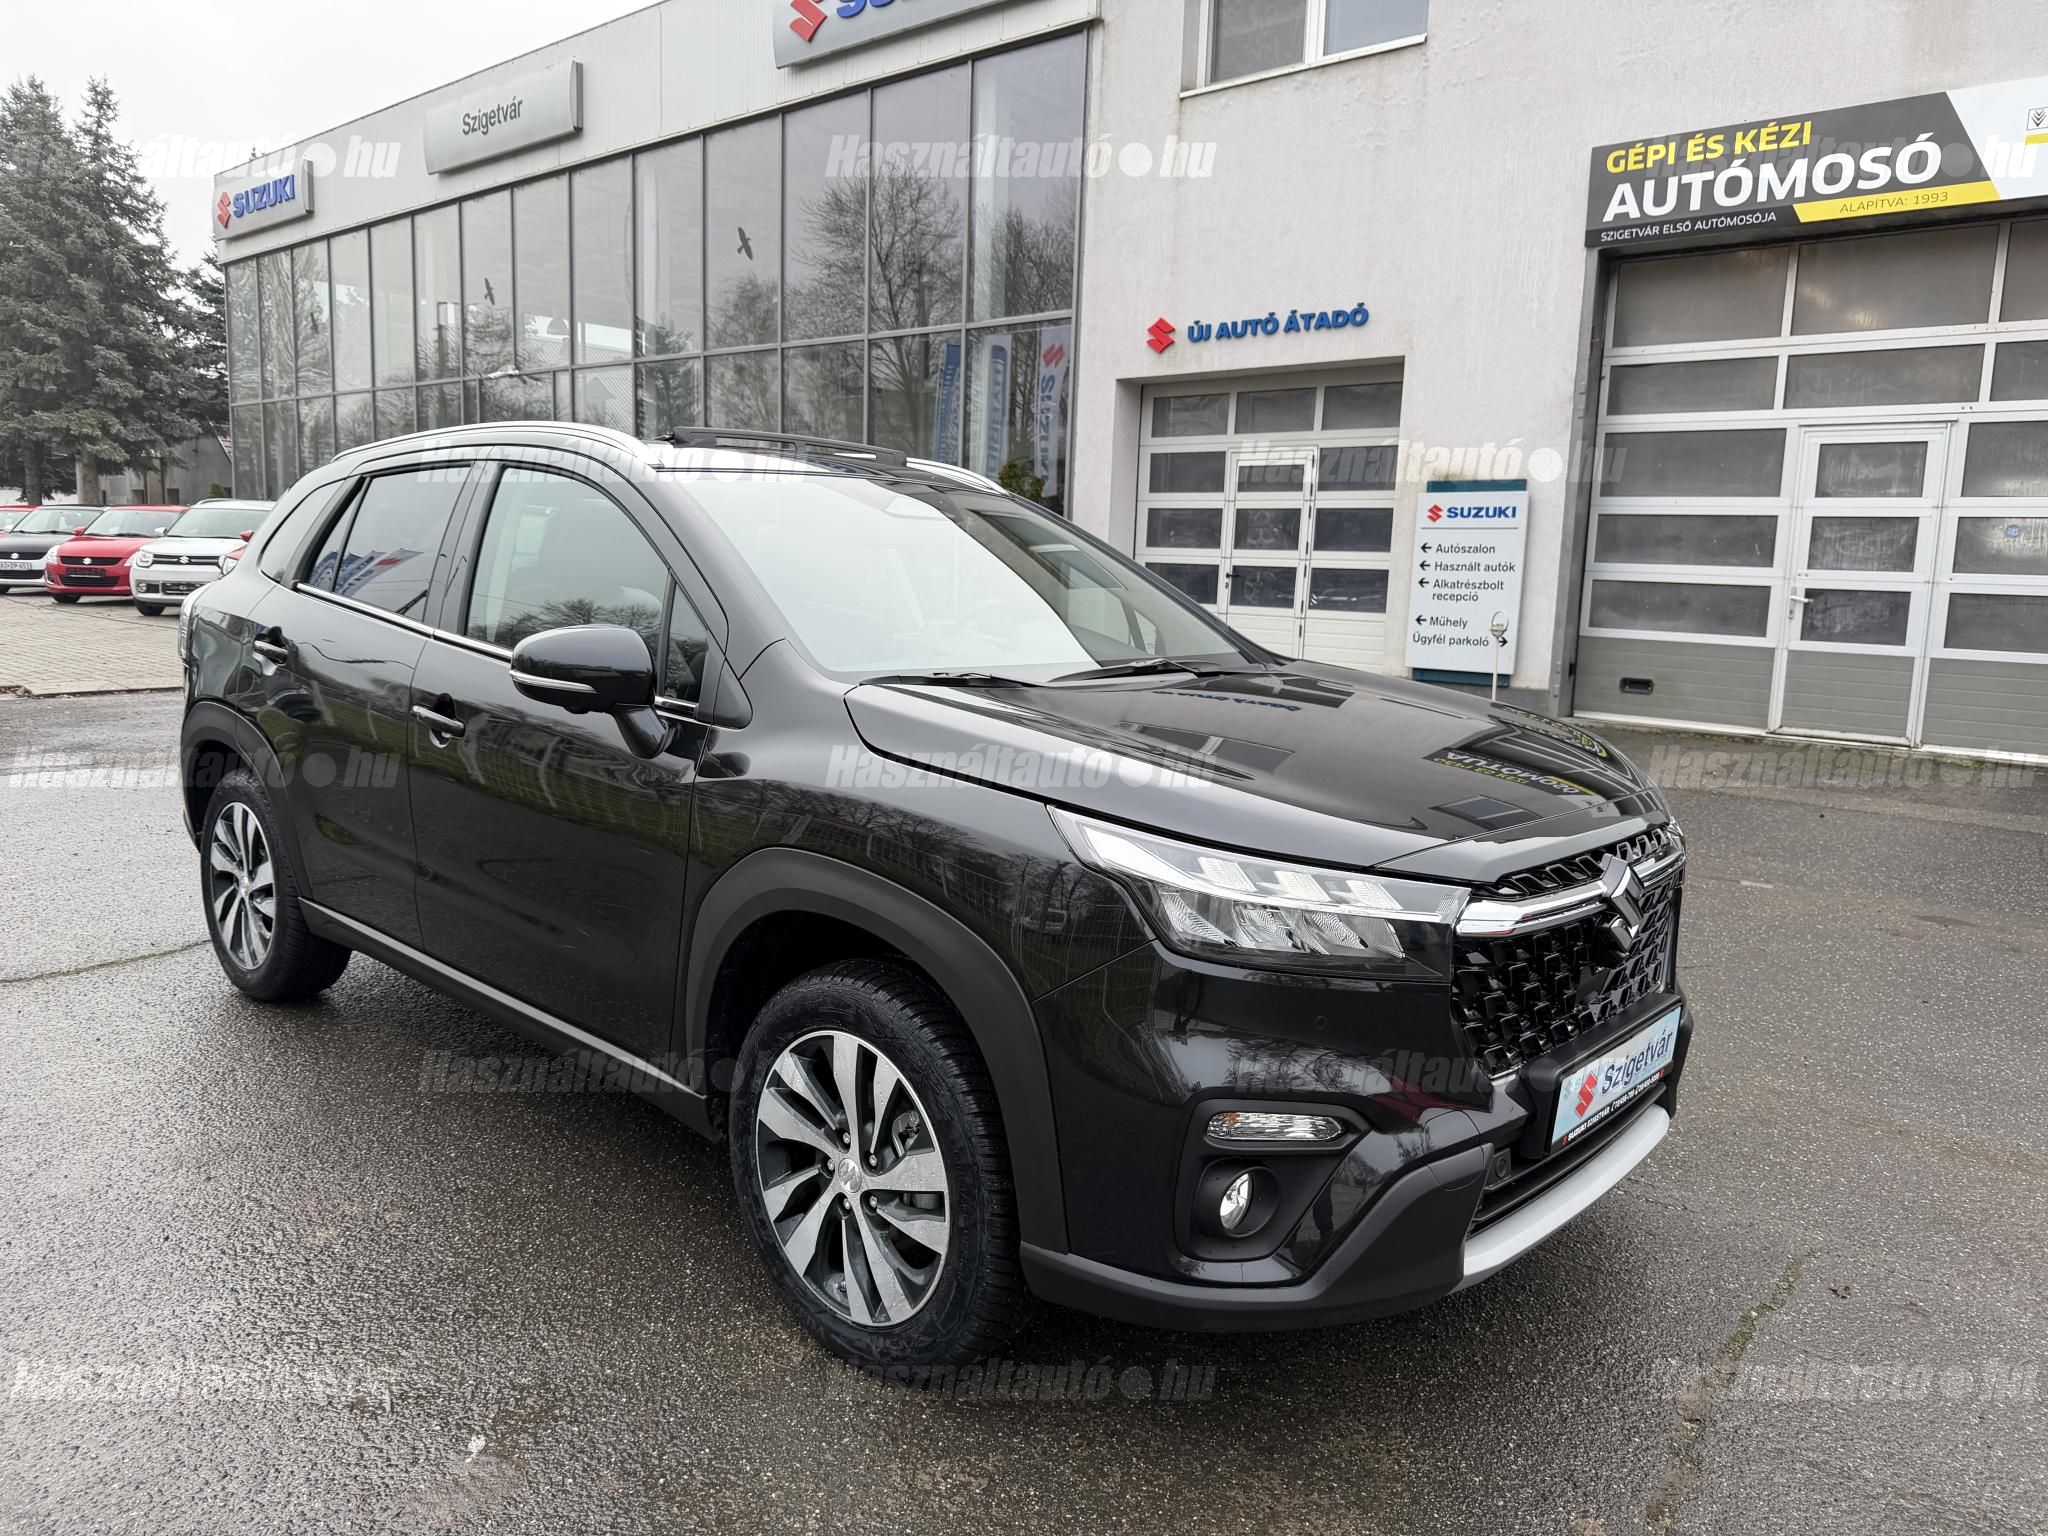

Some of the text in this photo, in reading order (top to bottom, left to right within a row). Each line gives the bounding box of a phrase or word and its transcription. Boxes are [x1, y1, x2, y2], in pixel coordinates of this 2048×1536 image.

[462, 95, 523, 136] Szigetvár
[1605, 120, 1812, 174] GÉPI ÉS KÉZI
[1602, 131, 1942, 223] AUTÓMOSÓ
[232, 174, 296, 218] SUZUKI
[1839, 191, 1949, 214] ALAPÍTVA: 1993
[1600, 225, 1660, 242] SZIGETVÁR
[1694, 211, 1777, 231] AUTÓMOSÓJA
[1187, 302, 1370, 343] ÚJ AUTÓ ÁTADÓ
[1446, 506, 1517, 519] SUZUKI
[1435, 543, 1496, 554] Autószalon
[1434, 561, 1516, 572] Használt autók
[1432, 579, 1504, 591] Alkatrészbolt
[1432, 591, 1479, 603] recepció
[1429, 616, 1468, 630] Műhely
[1412, 631, 1489, 647] Ügyfél parkoló
[1600, 1029, 1673, 1095] Szigetvár
